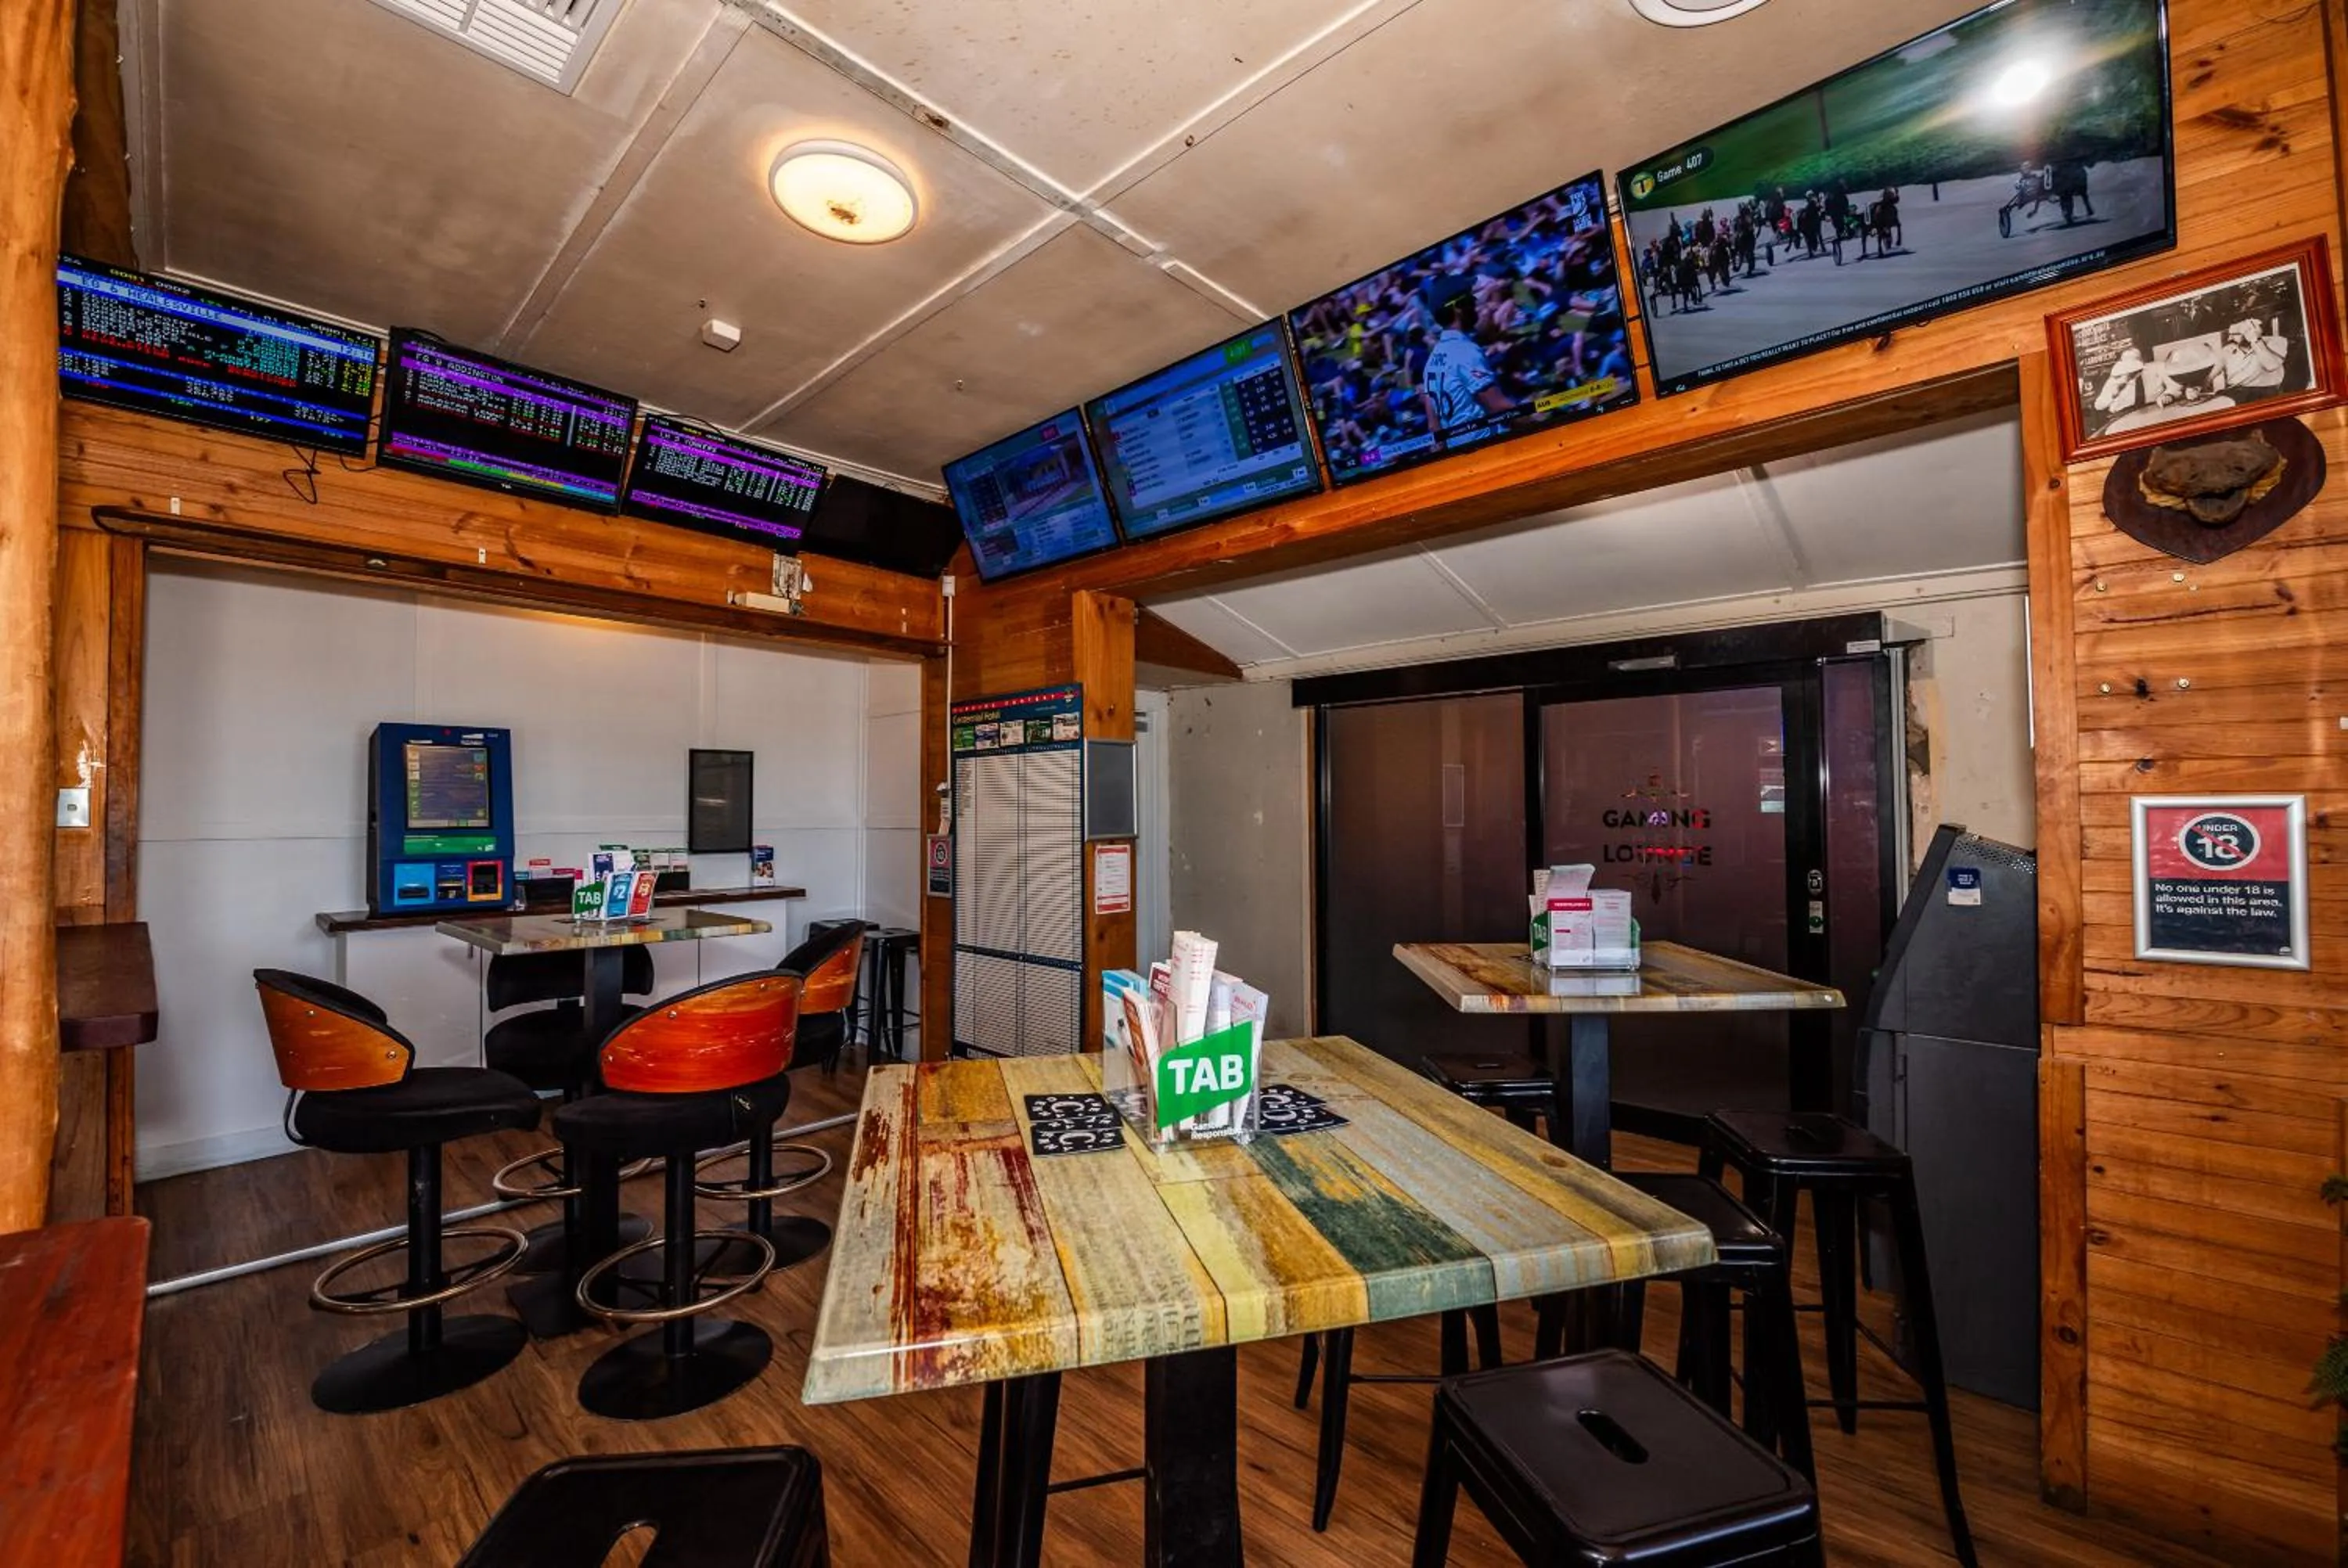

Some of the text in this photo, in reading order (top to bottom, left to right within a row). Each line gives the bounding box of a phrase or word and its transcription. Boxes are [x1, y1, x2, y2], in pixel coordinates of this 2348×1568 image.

[1657, 153, 1703, 182] Game 407
[1783, 340, 1800, 353] WANT
[1602, 808, 1711, 829] GAMING
[2197, 833, 2241, 859] 18
[2155, 883, 2275, 897] No one under 18 is
[577, 891, 602, 905] TAB
[2155, 894, 2283, 908] allowed in this area.
[2155, 904, 2278, 918] It's against the law.
[1167, 1054, 1244, 1095] TAB
